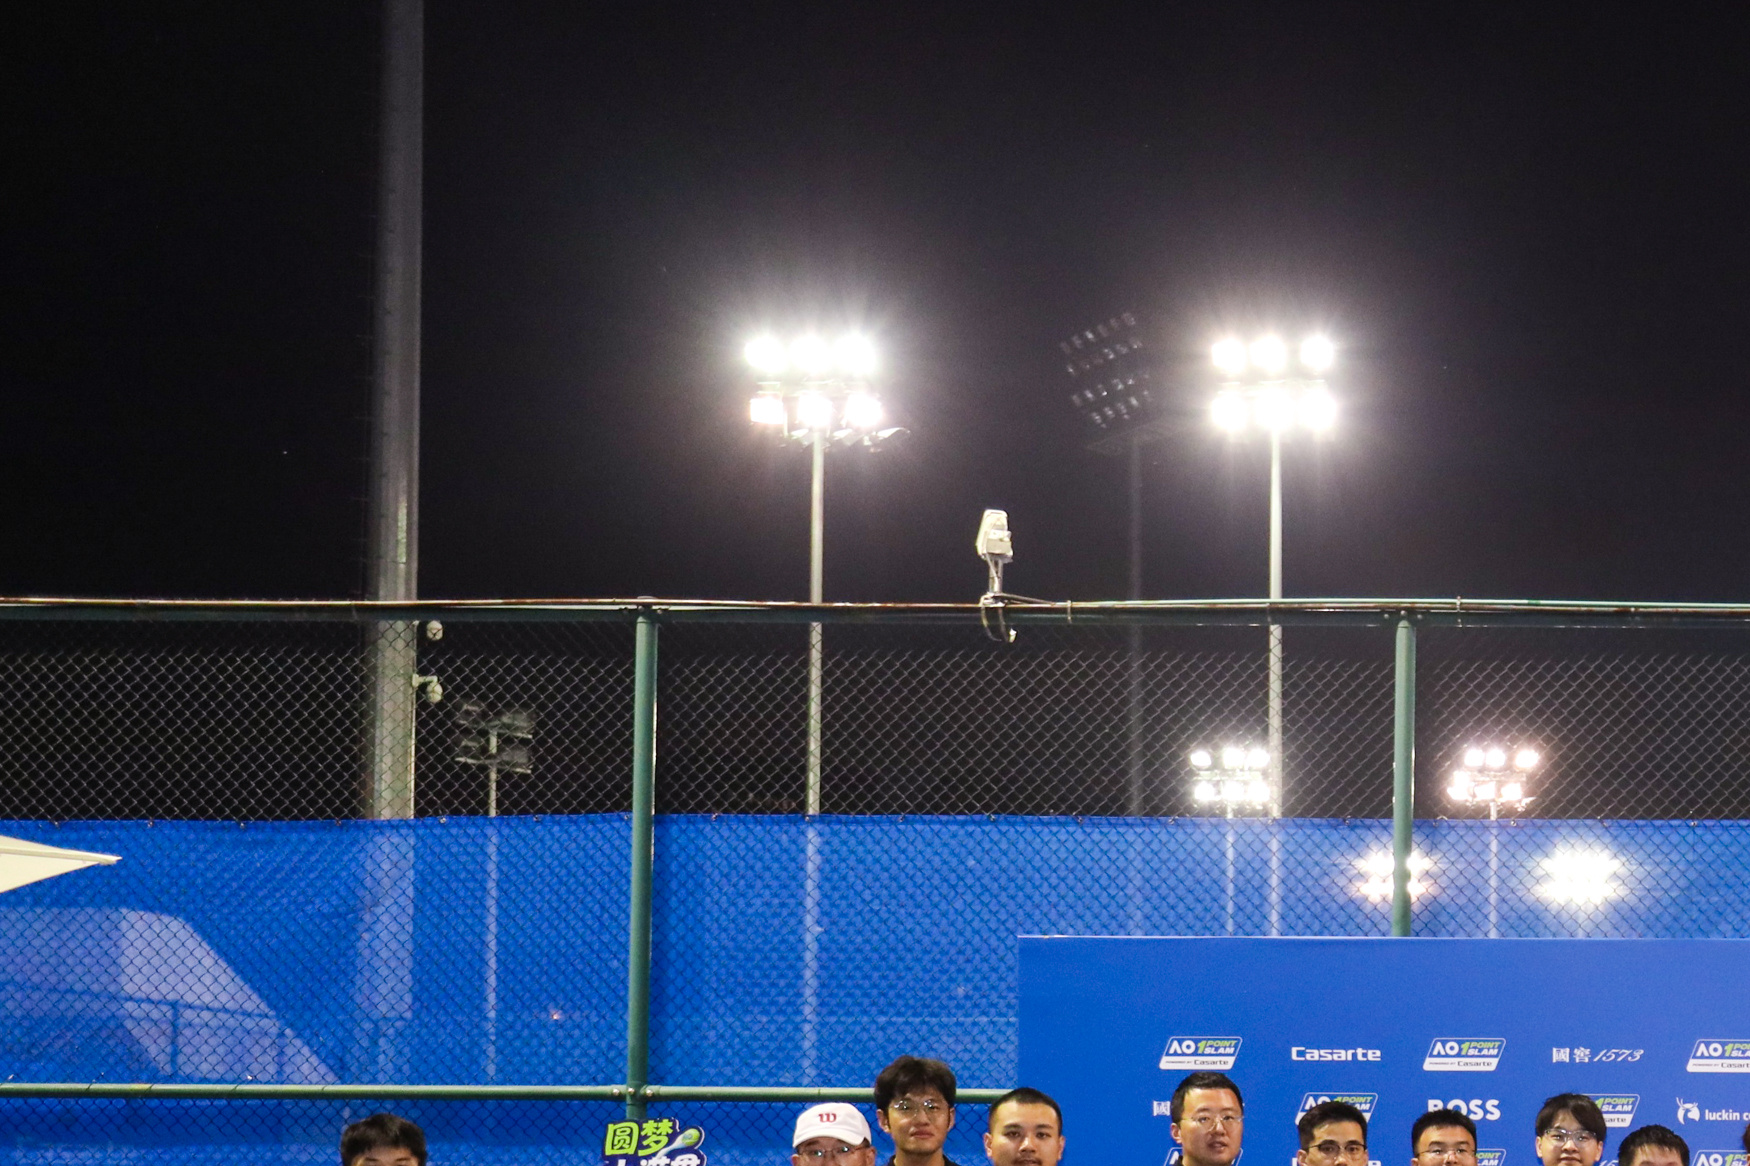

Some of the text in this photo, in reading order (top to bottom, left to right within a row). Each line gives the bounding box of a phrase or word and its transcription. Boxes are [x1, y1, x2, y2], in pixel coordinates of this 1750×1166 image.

[1169, 1040, 1196, 1054] AO
[1197, 1040, 1207, 1053] 1
[1292, 1047, 1381, 1061] Casarte
[1433, 1041, 1458, 1055] AO
[1461, 1041, 1470, 1054] 1
[1696, 1043, 1722, 1057] AO
[1724, 1043, 1733, 1056] 1
[1552, 1047, 1644, 1063] 國窖 1573
[1602, 1104, 1632, 1112] SLAM
[1705, 1109, 1740, 1121] luckin
[604, 1119, 674, 1156] 圆梦
